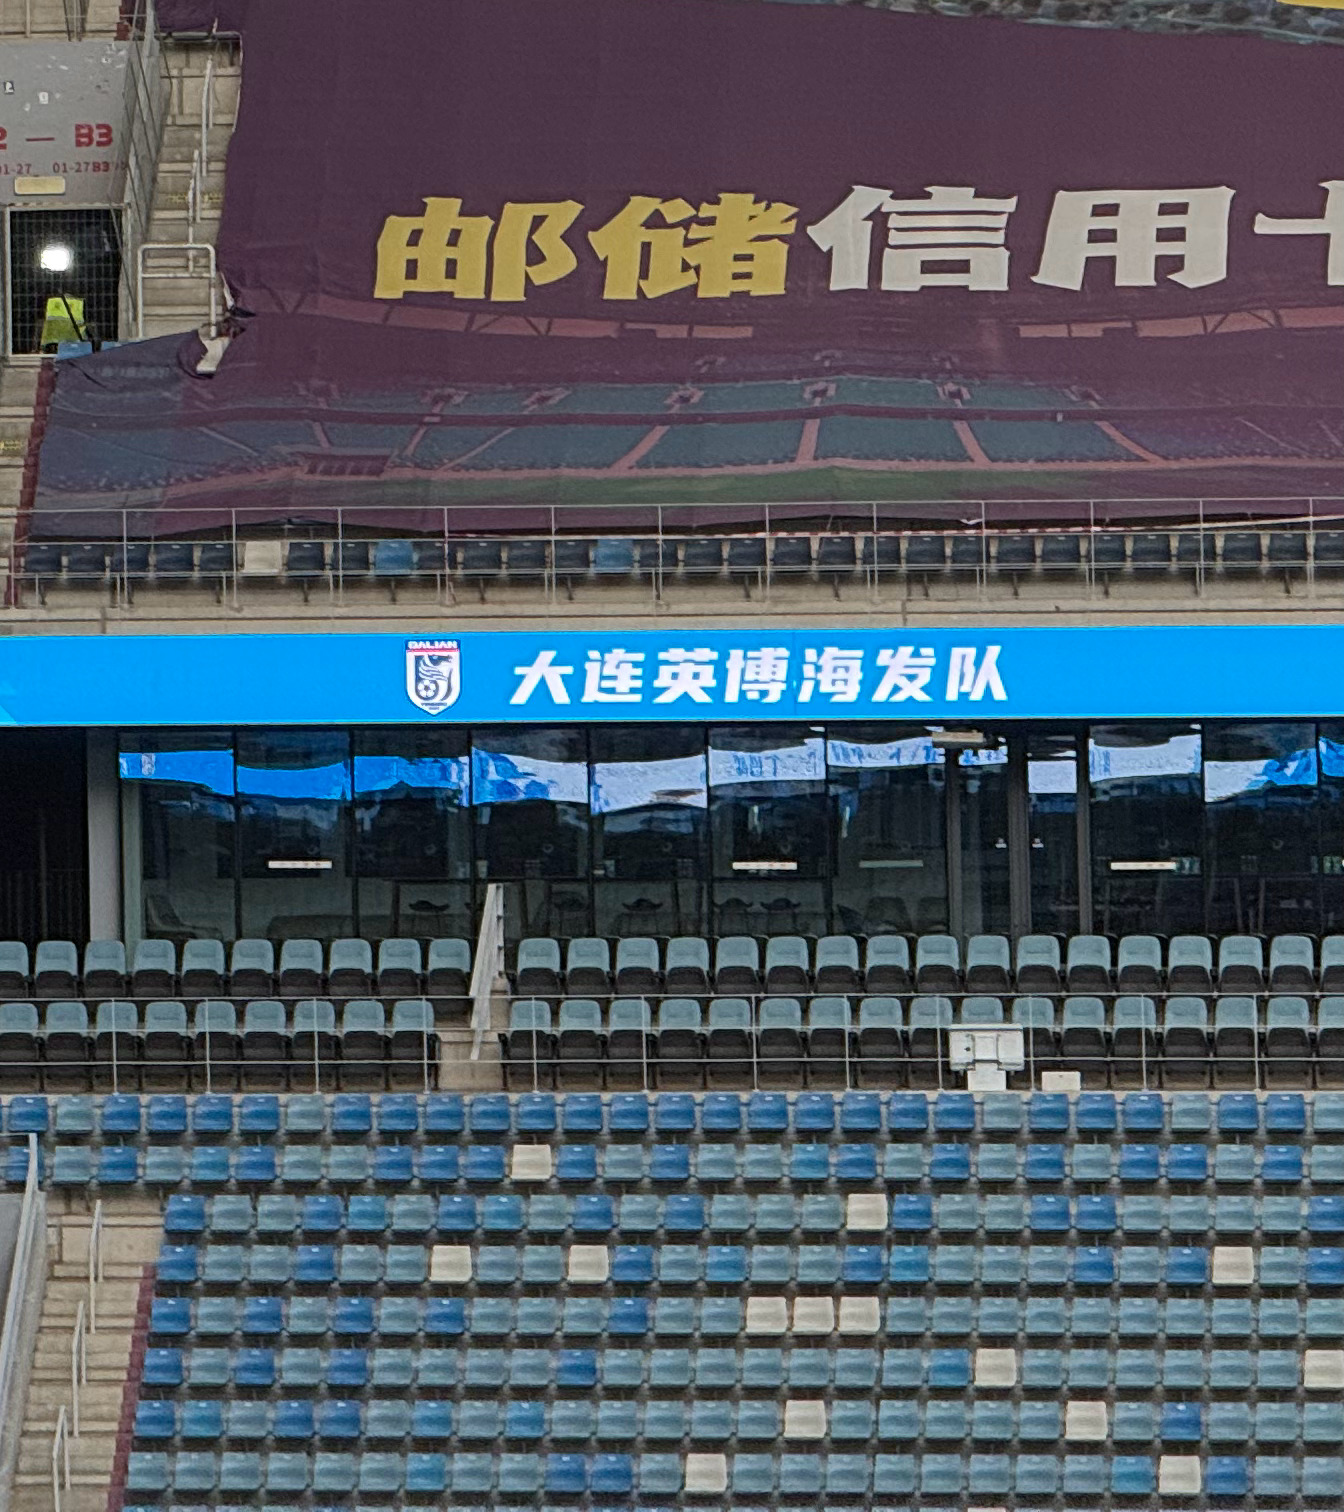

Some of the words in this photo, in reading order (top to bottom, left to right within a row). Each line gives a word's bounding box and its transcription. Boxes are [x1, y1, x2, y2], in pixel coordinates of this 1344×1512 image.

[74, 123, 113, 148] B3
[509, 645, 1008, 705] 大连英博海发队
